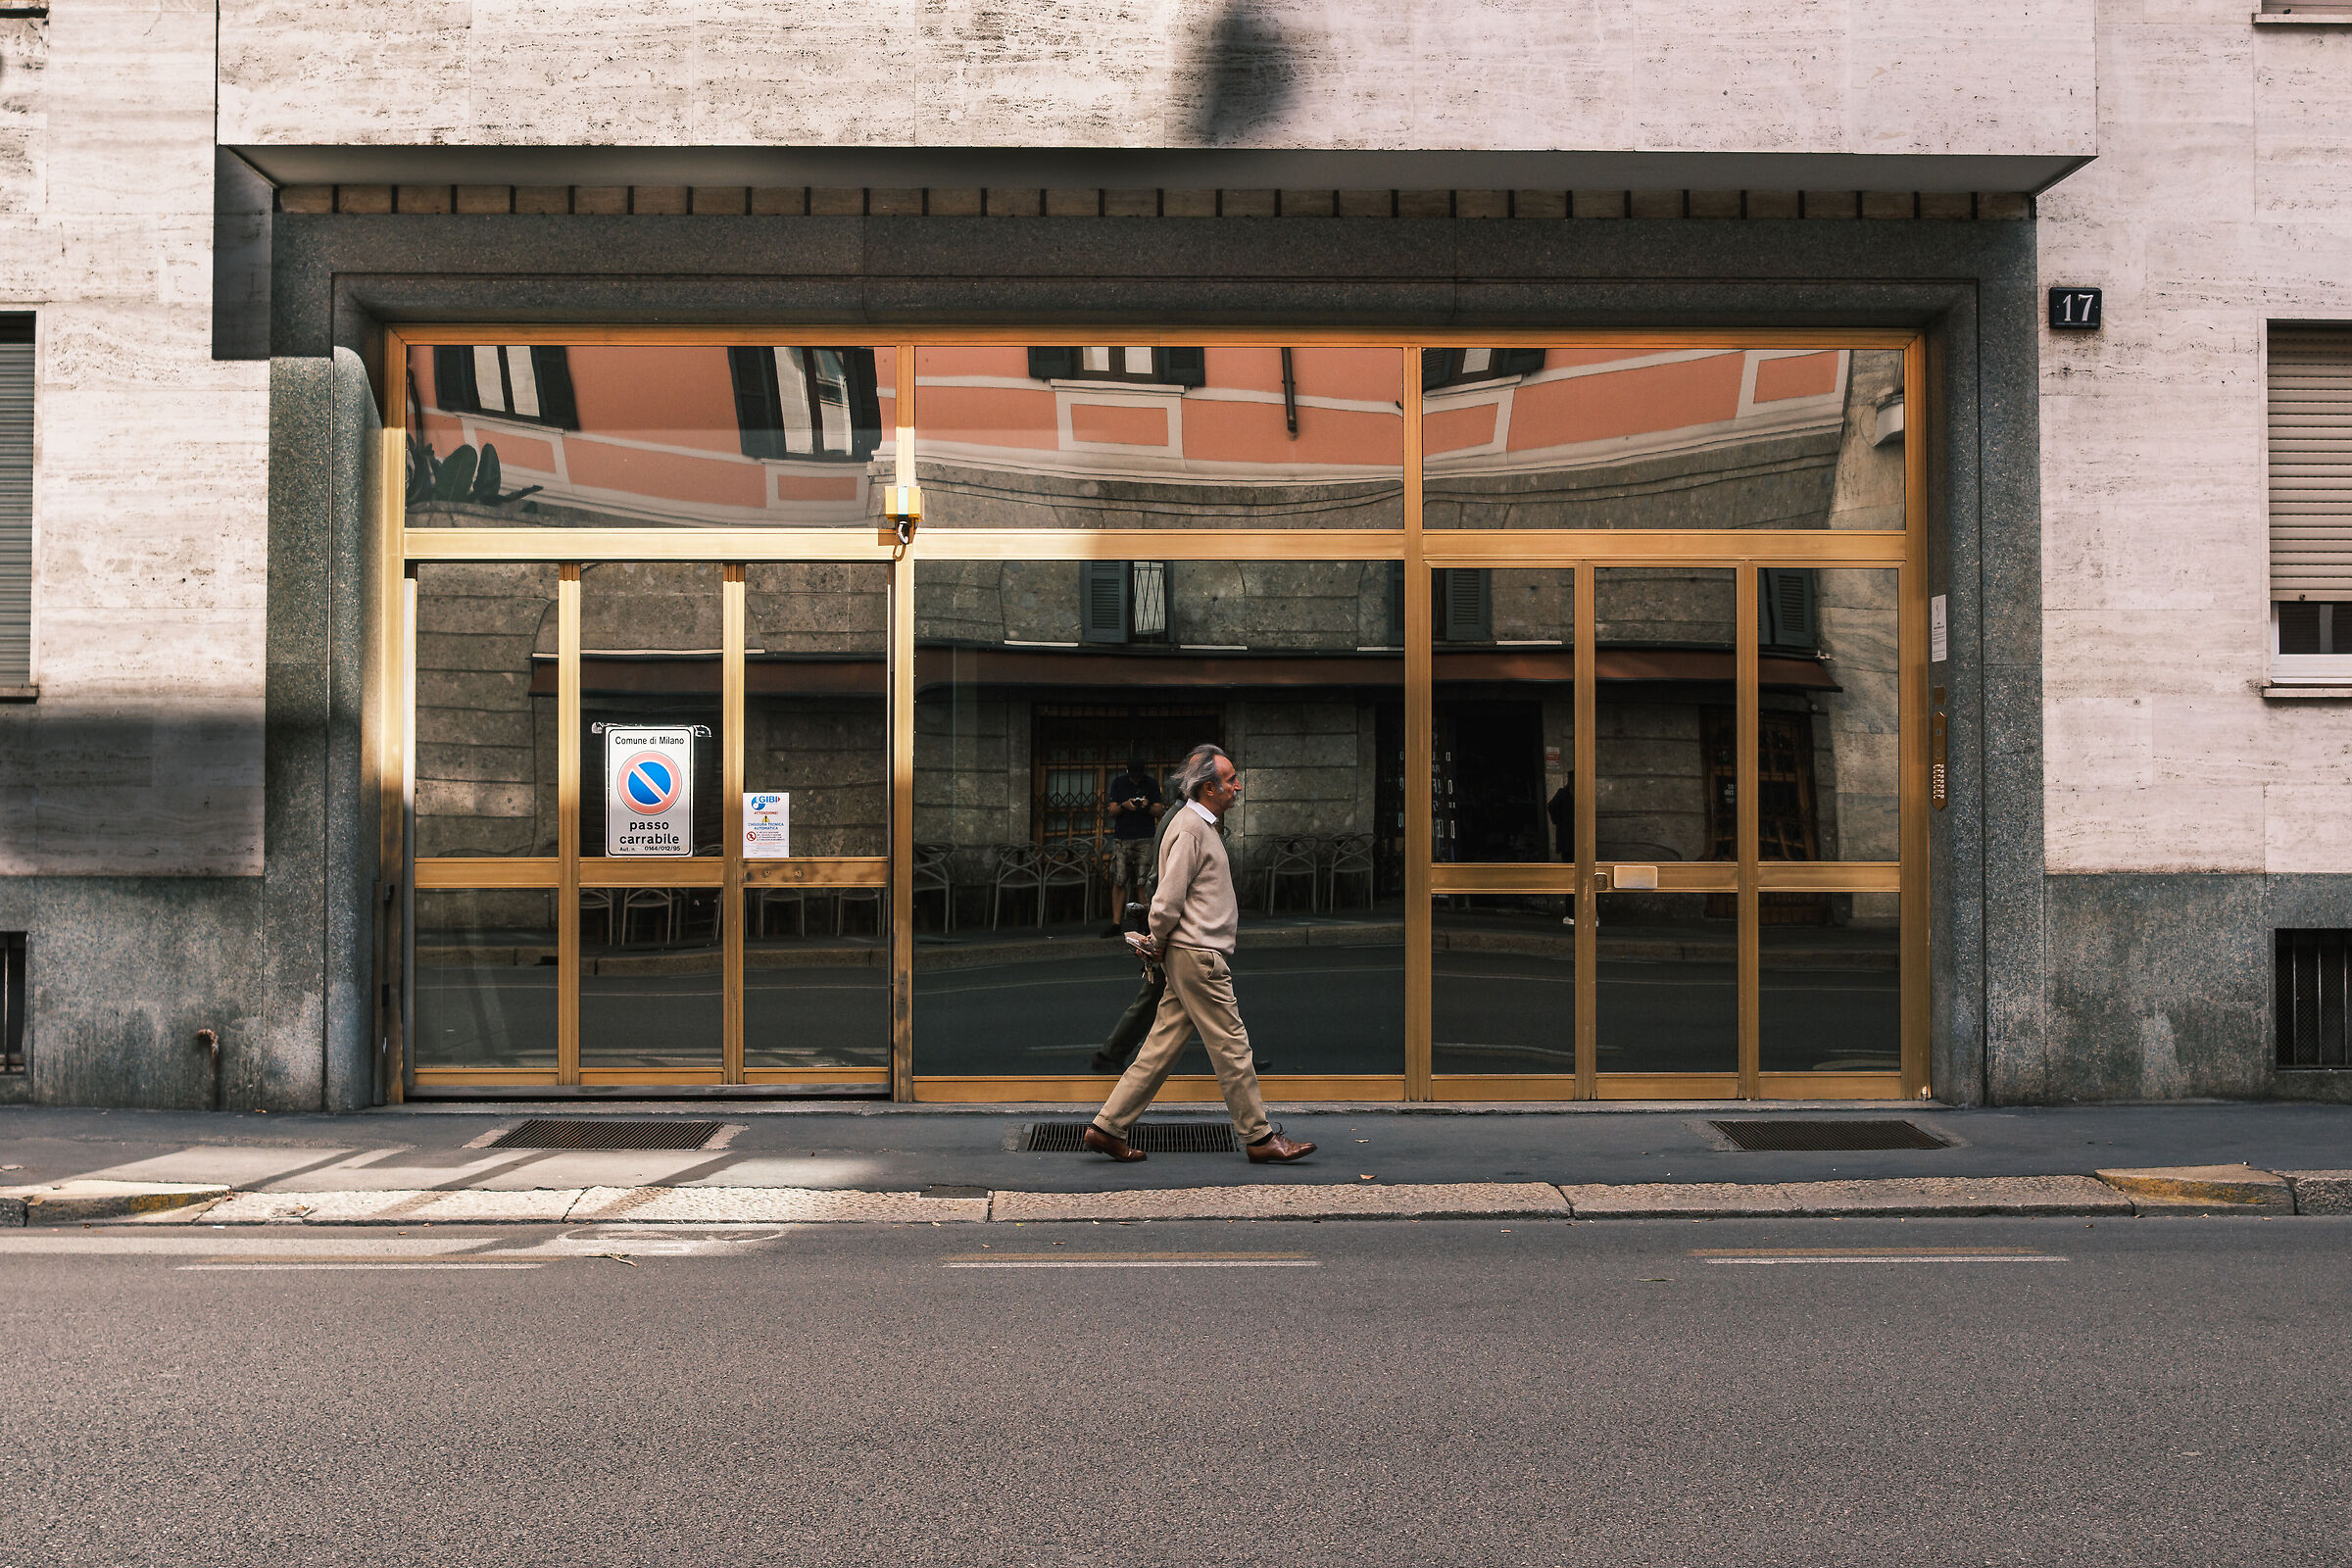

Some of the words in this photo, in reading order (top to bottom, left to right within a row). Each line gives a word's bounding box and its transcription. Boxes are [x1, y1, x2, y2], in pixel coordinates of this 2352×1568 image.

[2063, 294, 2093, 321] 17
[630, 822, 669, 831] passo
[619, 834, 679, 844] carrabile
